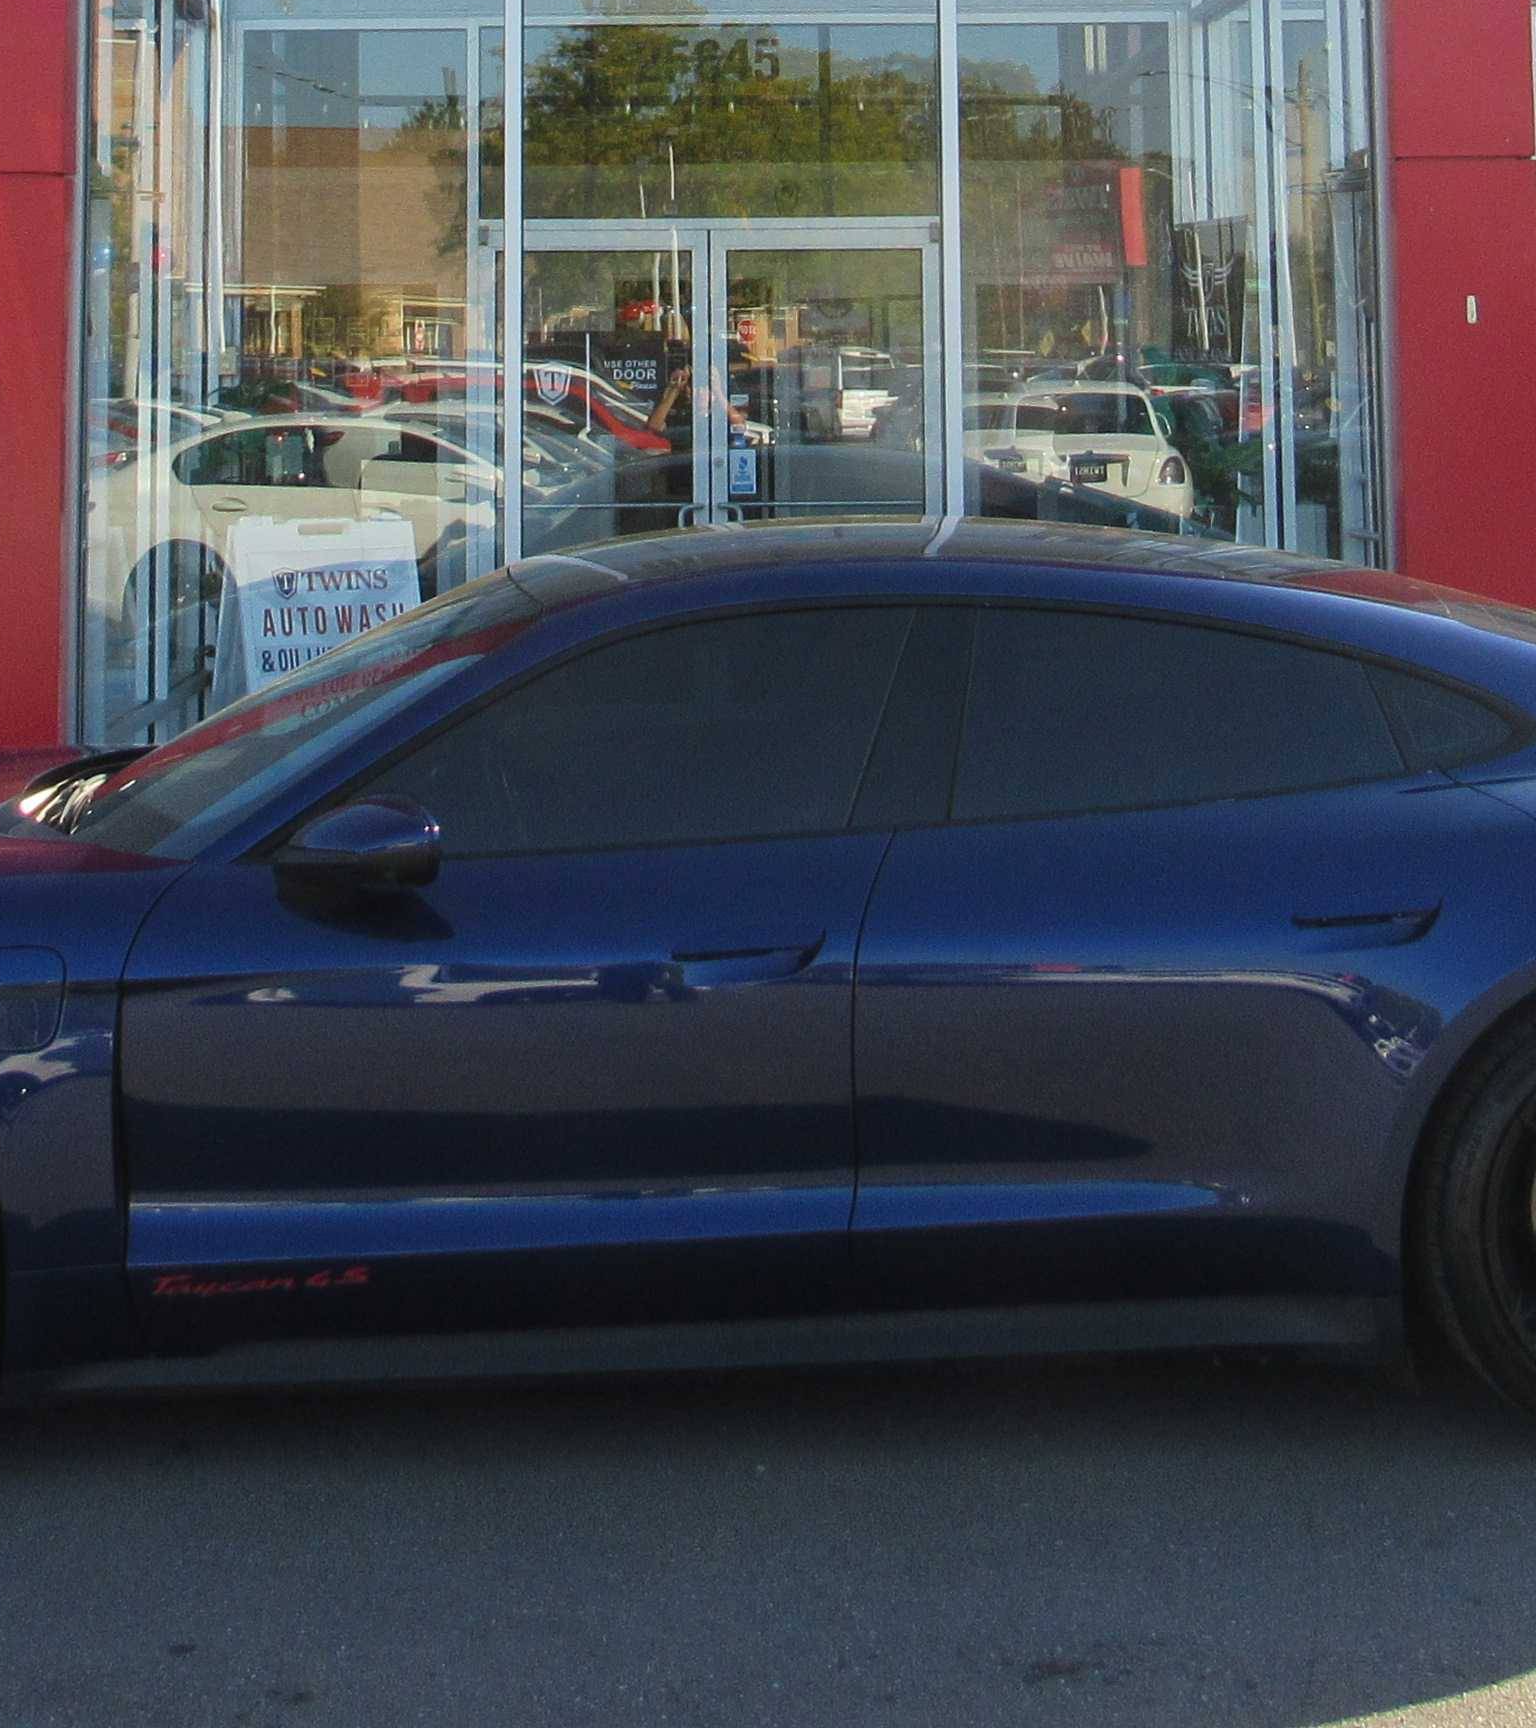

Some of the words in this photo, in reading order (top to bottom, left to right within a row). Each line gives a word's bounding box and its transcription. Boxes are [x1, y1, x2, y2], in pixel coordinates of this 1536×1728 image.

[604, 360, 622, 368] USE
[624, 359, 657, 368] OTHER
[613, 369, 657, 381] DOOR
[300, 568, 388, 592] TWINS
[263, 605, 327, 637] AUTO
[261, 649, 275, 673] &
